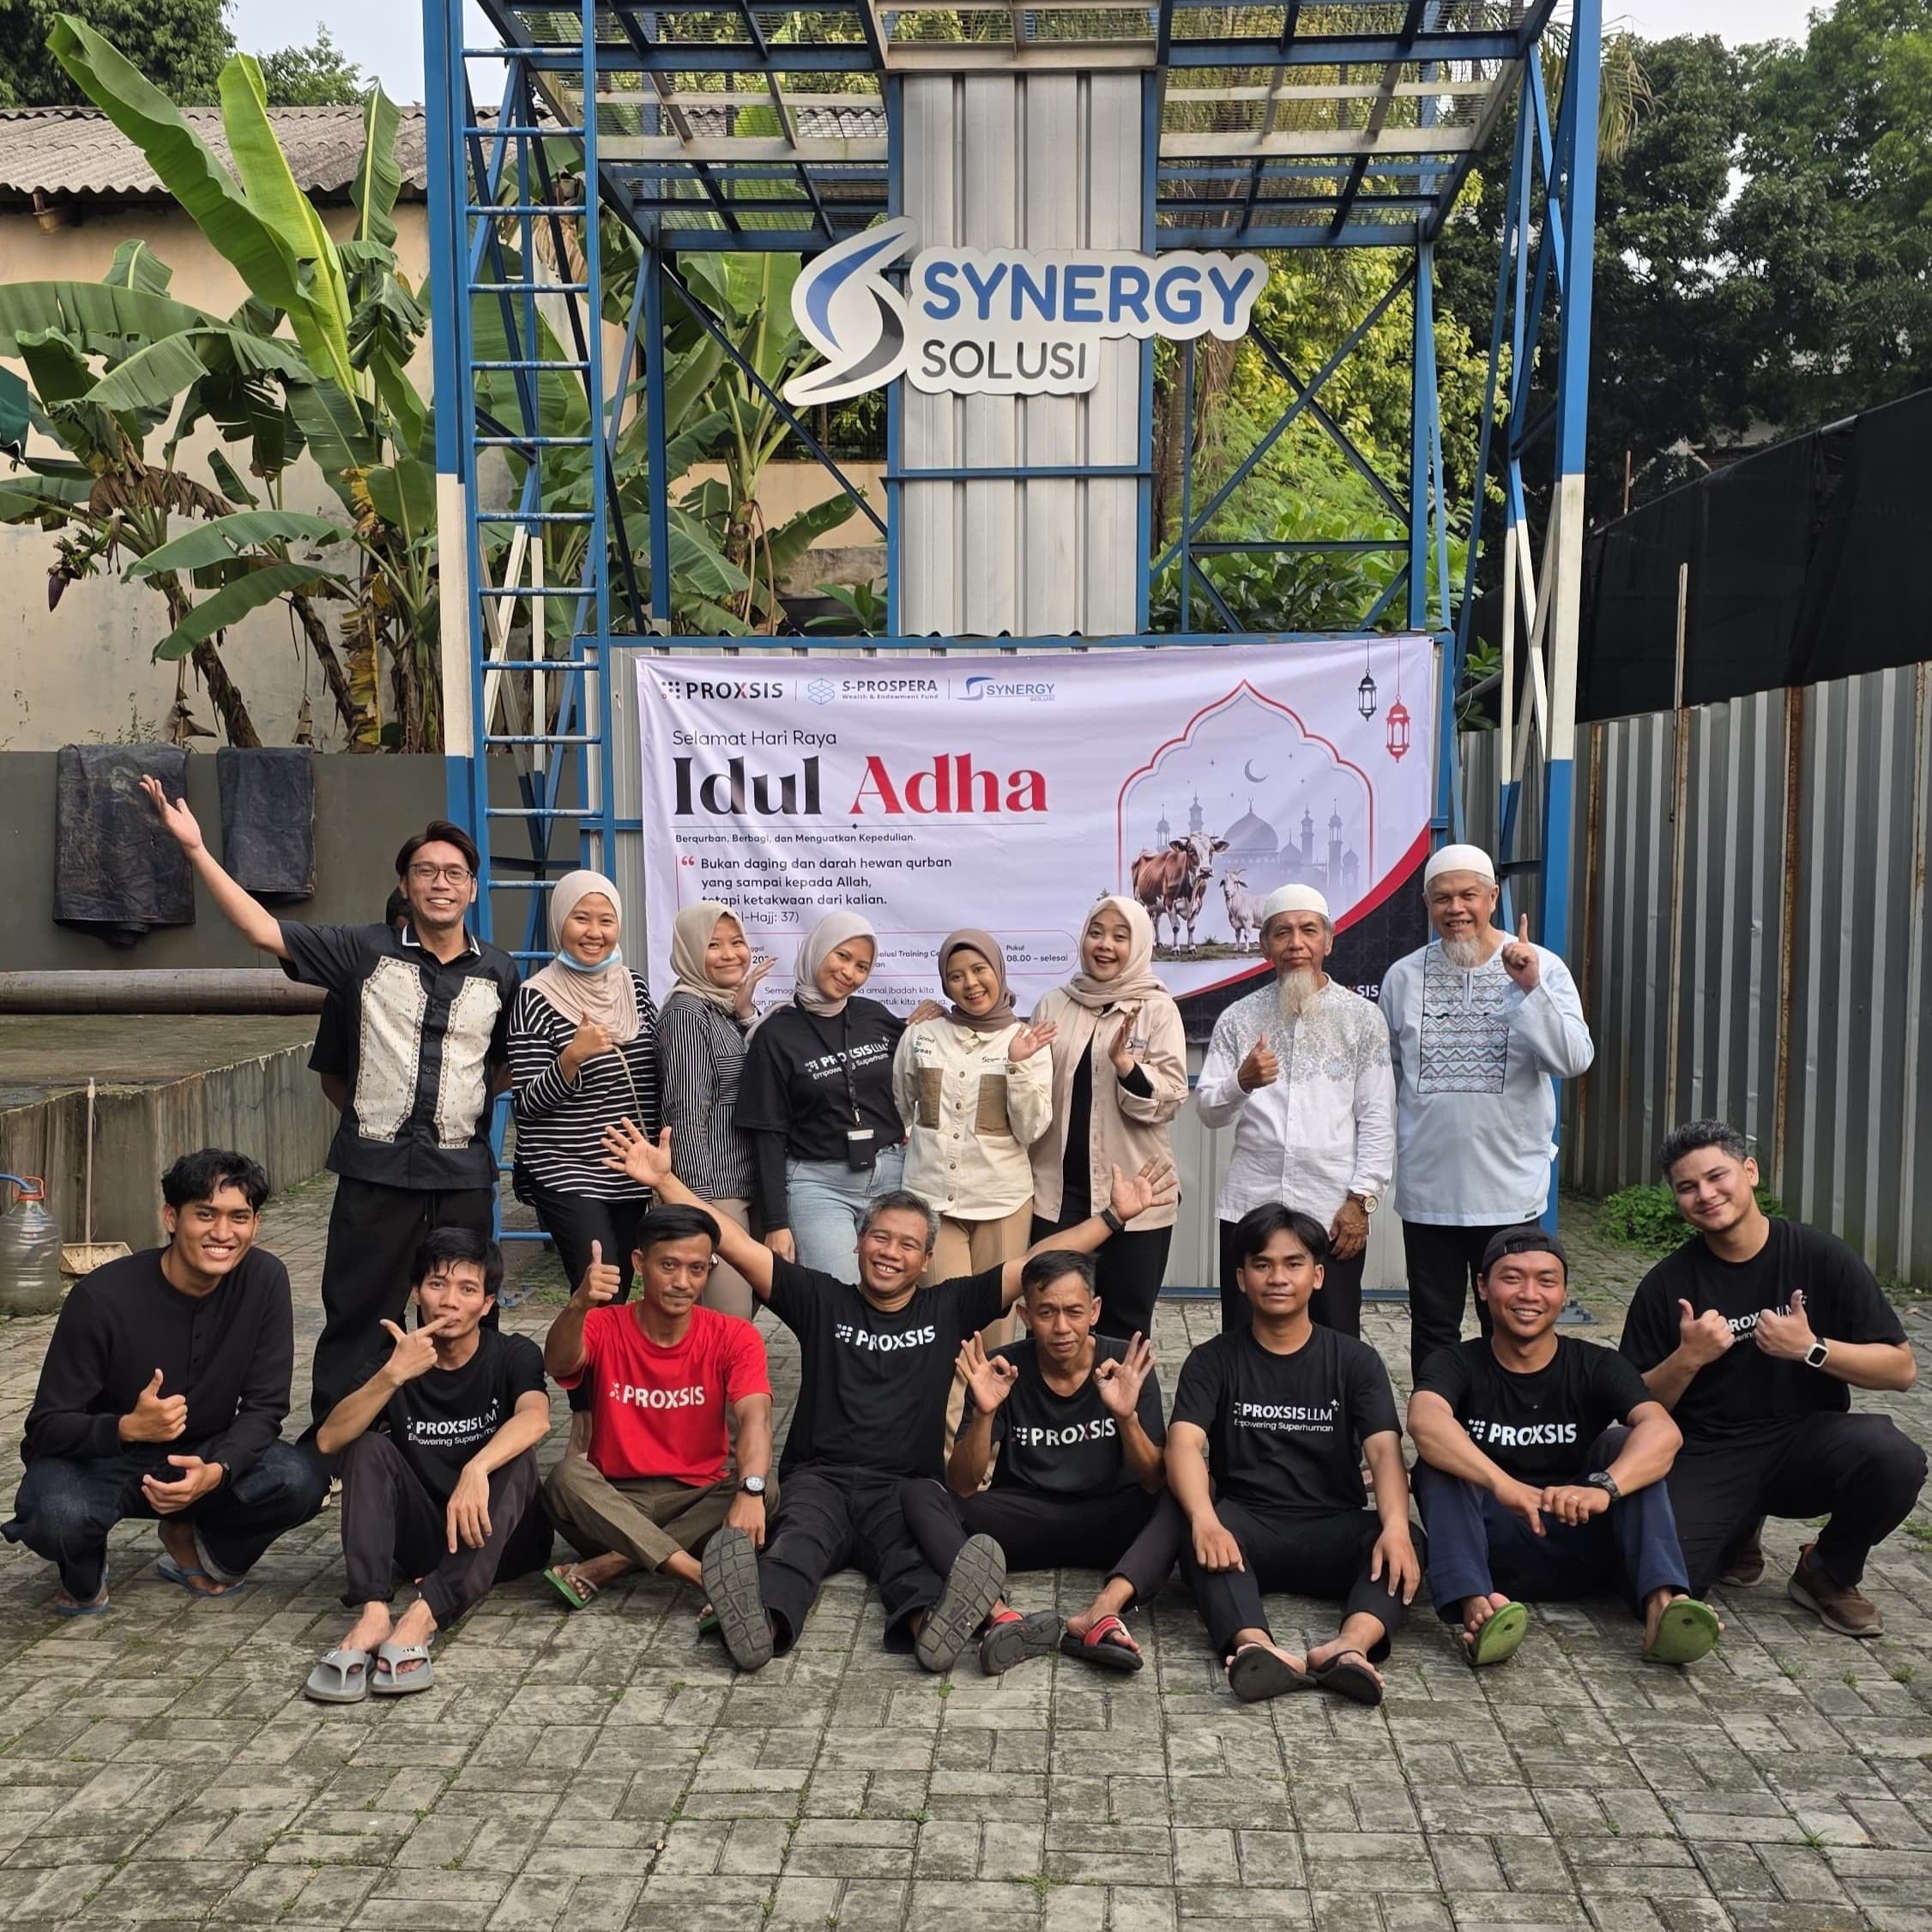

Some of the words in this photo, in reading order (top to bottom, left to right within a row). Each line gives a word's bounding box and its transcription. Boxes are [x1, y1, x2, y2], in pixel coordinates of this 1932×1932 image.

[923, 261, 1254, 326] SYNERGY
[921, 339, 1086, 380] SOLUSI
[686, 682, 784, 699] PROXSIS
[842, 679, 938, 691] S-PROSPERA
[987, 684, 1055, 695] SYNERGY
[673, 730, 746, 746] Selamat
[752, 730, 788, 746] Hari
[793, 730, 836, 748] Raya
[673, 755, 823, 816] Idul
[848, 752, 1049, 815] Adha
[675, 834, 729, 845] Berqurban,
[732, 834, 771, 844] Berbagi,
[775, 834, 793, 842] dan
[795, 833, 857, 844] Menguatkan
[859, 833, 916, 844] Kepedulian.
[701, 858, 740, 869] Bukan
[744, 858, 788, 871] daging
[791, 858, 816, 869] dan
[819, 857, 856, 869] darah
[860, 857, 903, 868] hewan
[906, 856, 952, 871] qurban
[701, 878, 733, 890] yang
[736, 876, 782, 890] sampai
[785, 875, 833, 889] kepada
[836, 875, 872, 888] Allah,
[744, 894, 813, 905] ketakwaan
[817, 893, 842, 905] dari
[846, 893, 888, 905] kalian.
[781, 911, 800, 924] 37)
[898, 949, 928, 958] Training
[1006, 954, 1031, 963] 08.00
[1040, 953, 1068, 962] selesai
[866, 986, 887, 994] amal
[889, 986, 917, 994] ibadah
[855, 1325, 936, 1352] PROXSIS
[623, 1384, 705, 1410] PROXSIS
[1031, 1417, 1117, 1446] PROXSIS
[1277, 1421, 1333, 1432] Superhuman
[1488, 1422, 1577, 1446] PROXSIS
